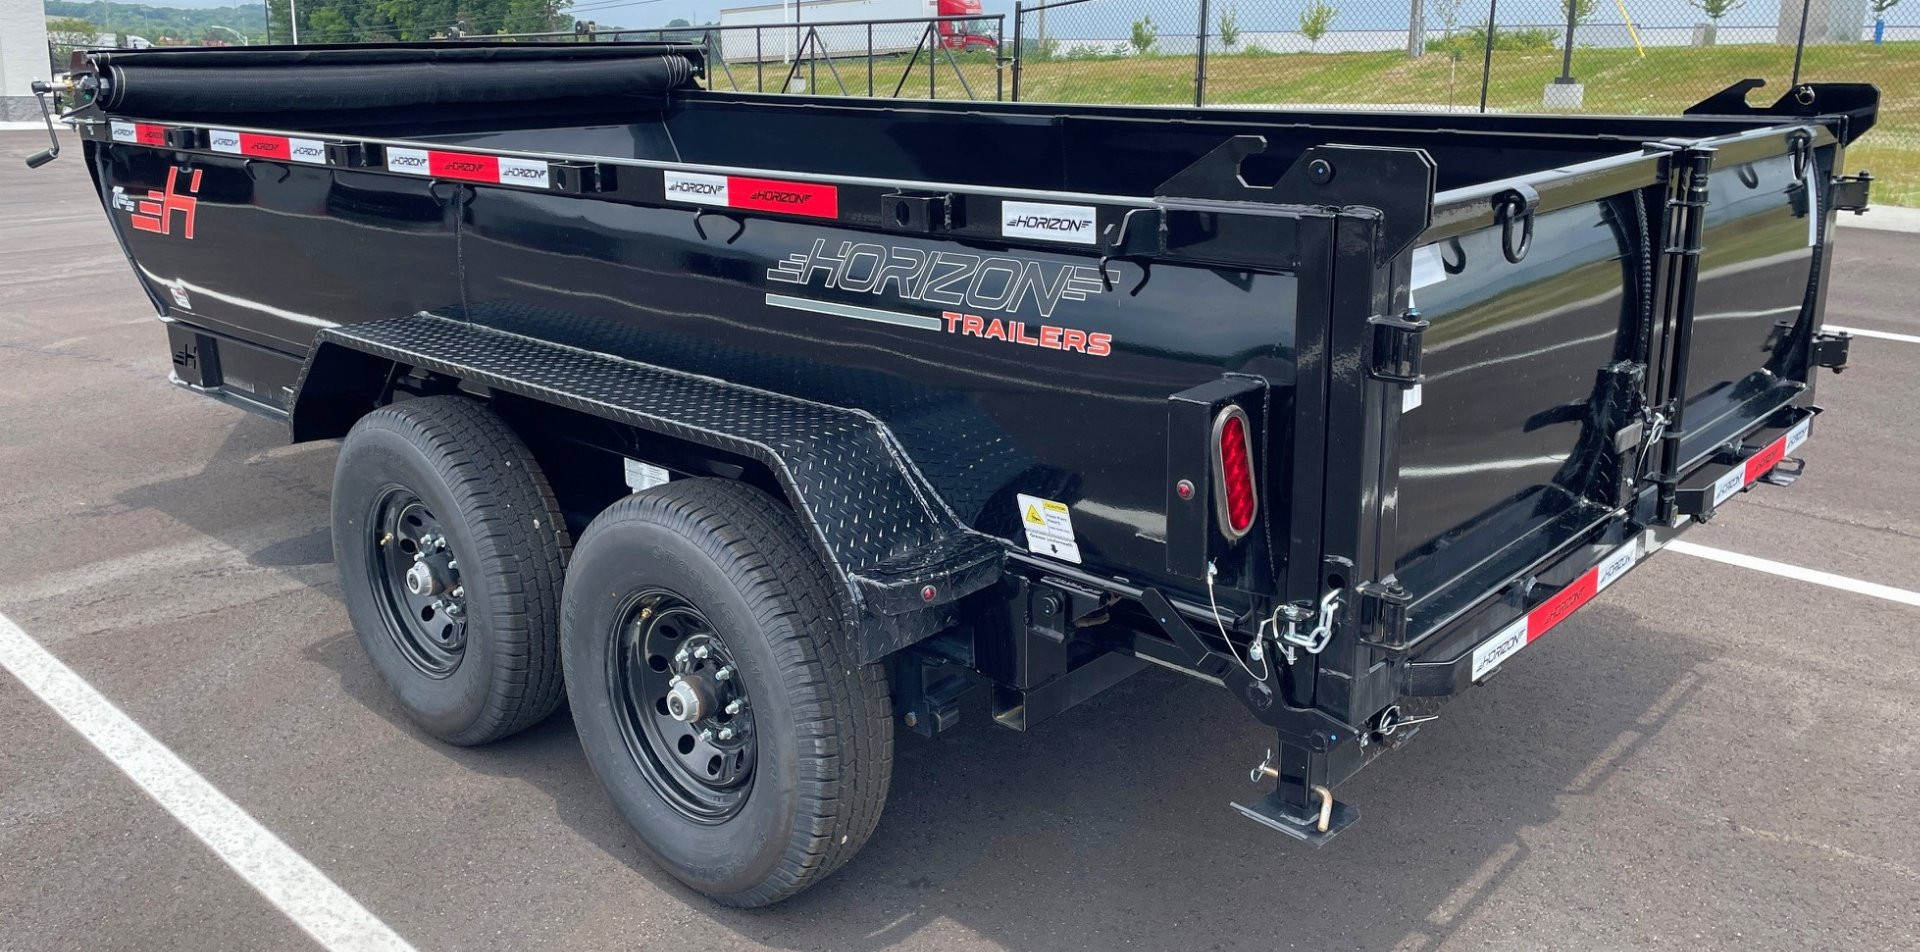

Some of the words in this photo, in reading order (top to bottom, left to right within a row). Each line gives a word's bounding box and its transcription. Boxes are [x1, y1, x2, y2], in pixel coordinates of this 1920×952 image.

[215, 136, 237, 147] HORIZON
[296, 146, 320, 157] HORIZON
[393, 156, 423, 168] HORIZON
[448, 161, 480, 173] HORIZON
[507, 167, 542, 180] HORIZON
[674, 181, 718, 195] HORIZON
[756, 190, 806, 204] HORIZON
[1014, 214, 1085, 233] HORIZON
[797, 237, 1076, 319] HORIZON
[942, 310, 1113, 357] TRAILERS
[1481, 633, 1521, 668] HORIZON
